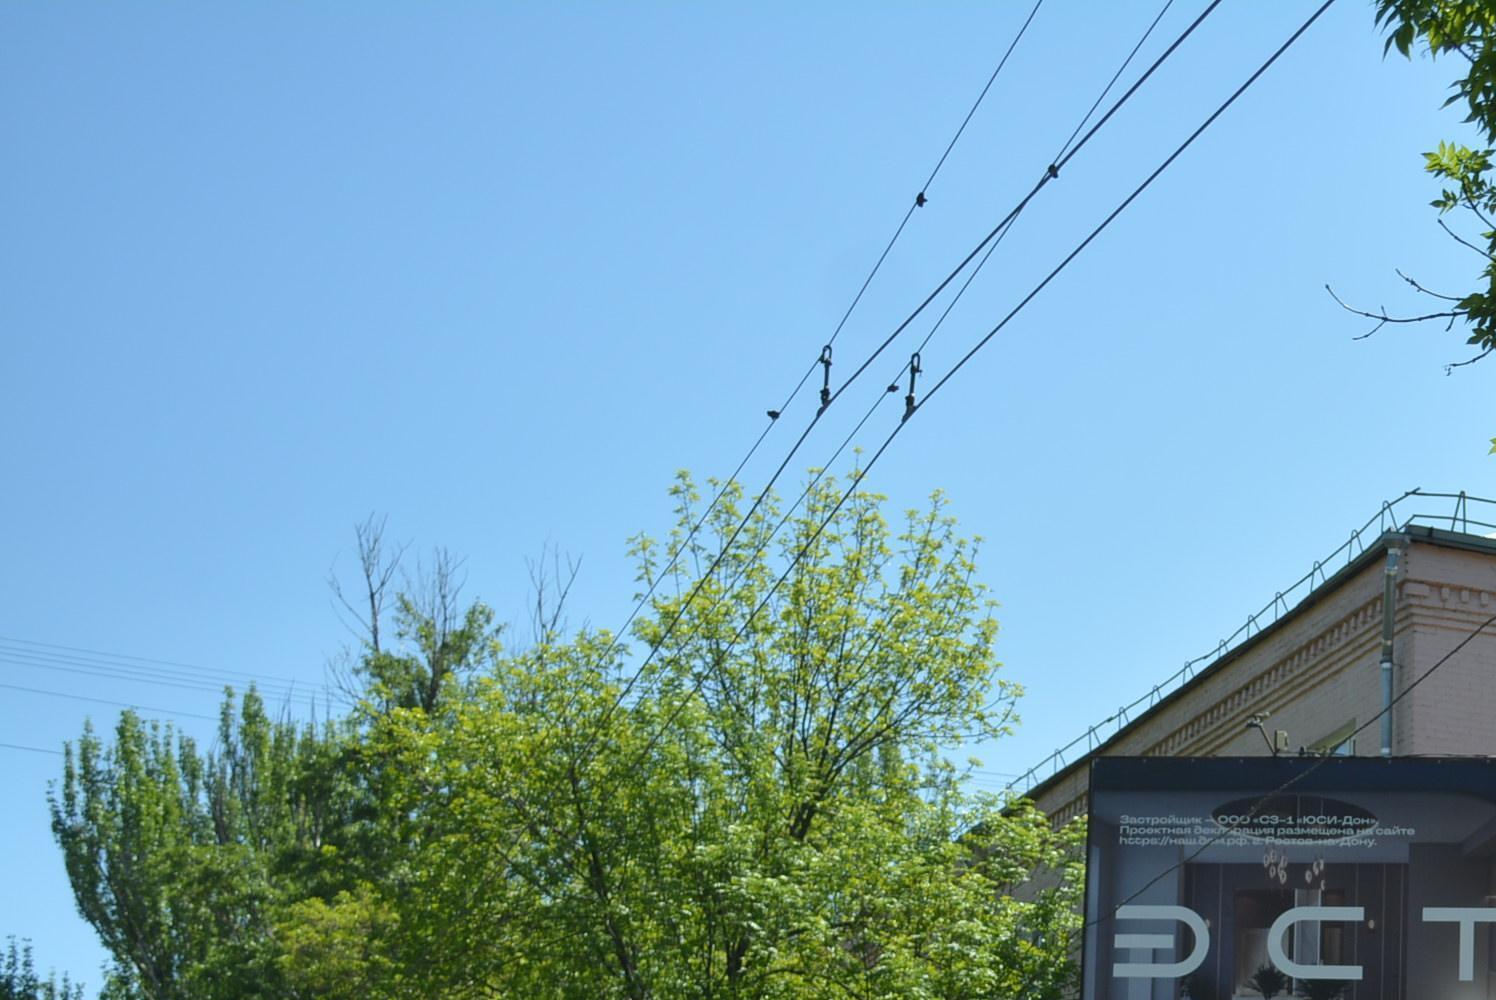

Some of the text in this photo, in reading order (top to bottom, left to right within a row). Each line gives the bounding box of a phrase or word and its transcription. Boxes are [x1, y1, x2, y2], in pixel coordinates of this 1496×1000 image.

[1119, 814, 1203, 826] Застройщик
[1217, 815, 1250, 825] ООО
[1119, 825, 1192, 836] Проектная
[1277, 827, 1355, 837] размещена
[1356, 828, 1374, 836] на
[1375, 825, 1416, 836] сайте
